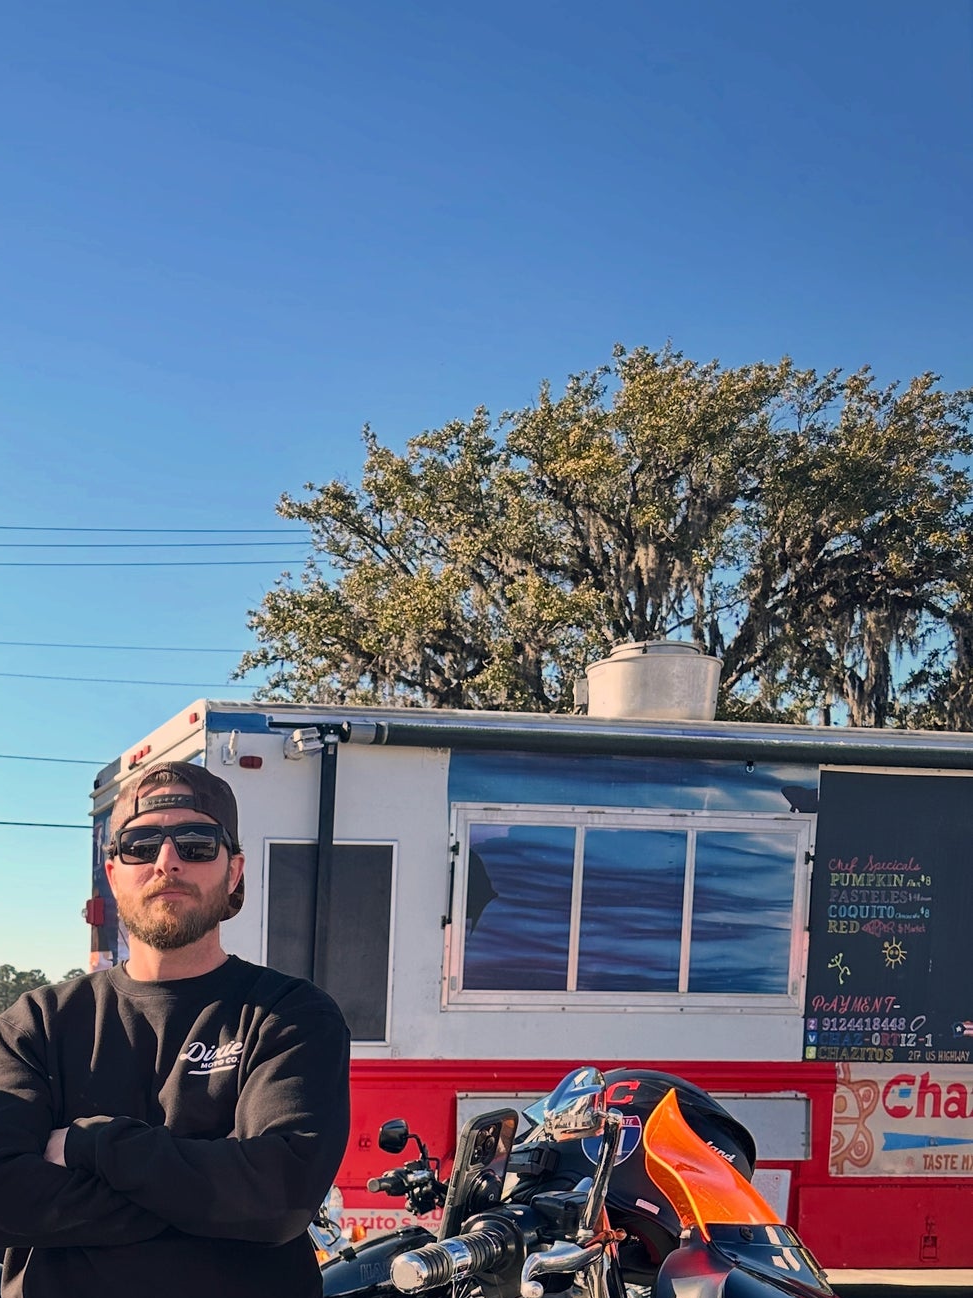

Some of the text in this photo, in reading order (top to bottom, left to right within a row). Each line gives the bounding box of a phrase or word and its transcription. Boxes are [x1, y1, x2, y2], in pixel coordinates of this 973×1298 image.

[828, 857, 858, 873] Chef
[830, 873, 904, 887] PUMPKIN
[829, 889, 908, 903] PASTELES
[828, 905, 895, 918] COQUITO
[828, 920, 860, 933] RED
[822, 1017, 906, 1031] 9124418448
[180, 1041, 244, 1062] Dixie
[817, 1047, 894, 1061] CHAZITOS
[925, 1051, 935, 1060] US
[938, 1051, 970, 1061] HIGHWAY
[201, 1060, 224, 1068] MOTO
[882, 1072, 973, 1118] Cha
[923, 1154, 958, 1170] TASTE
